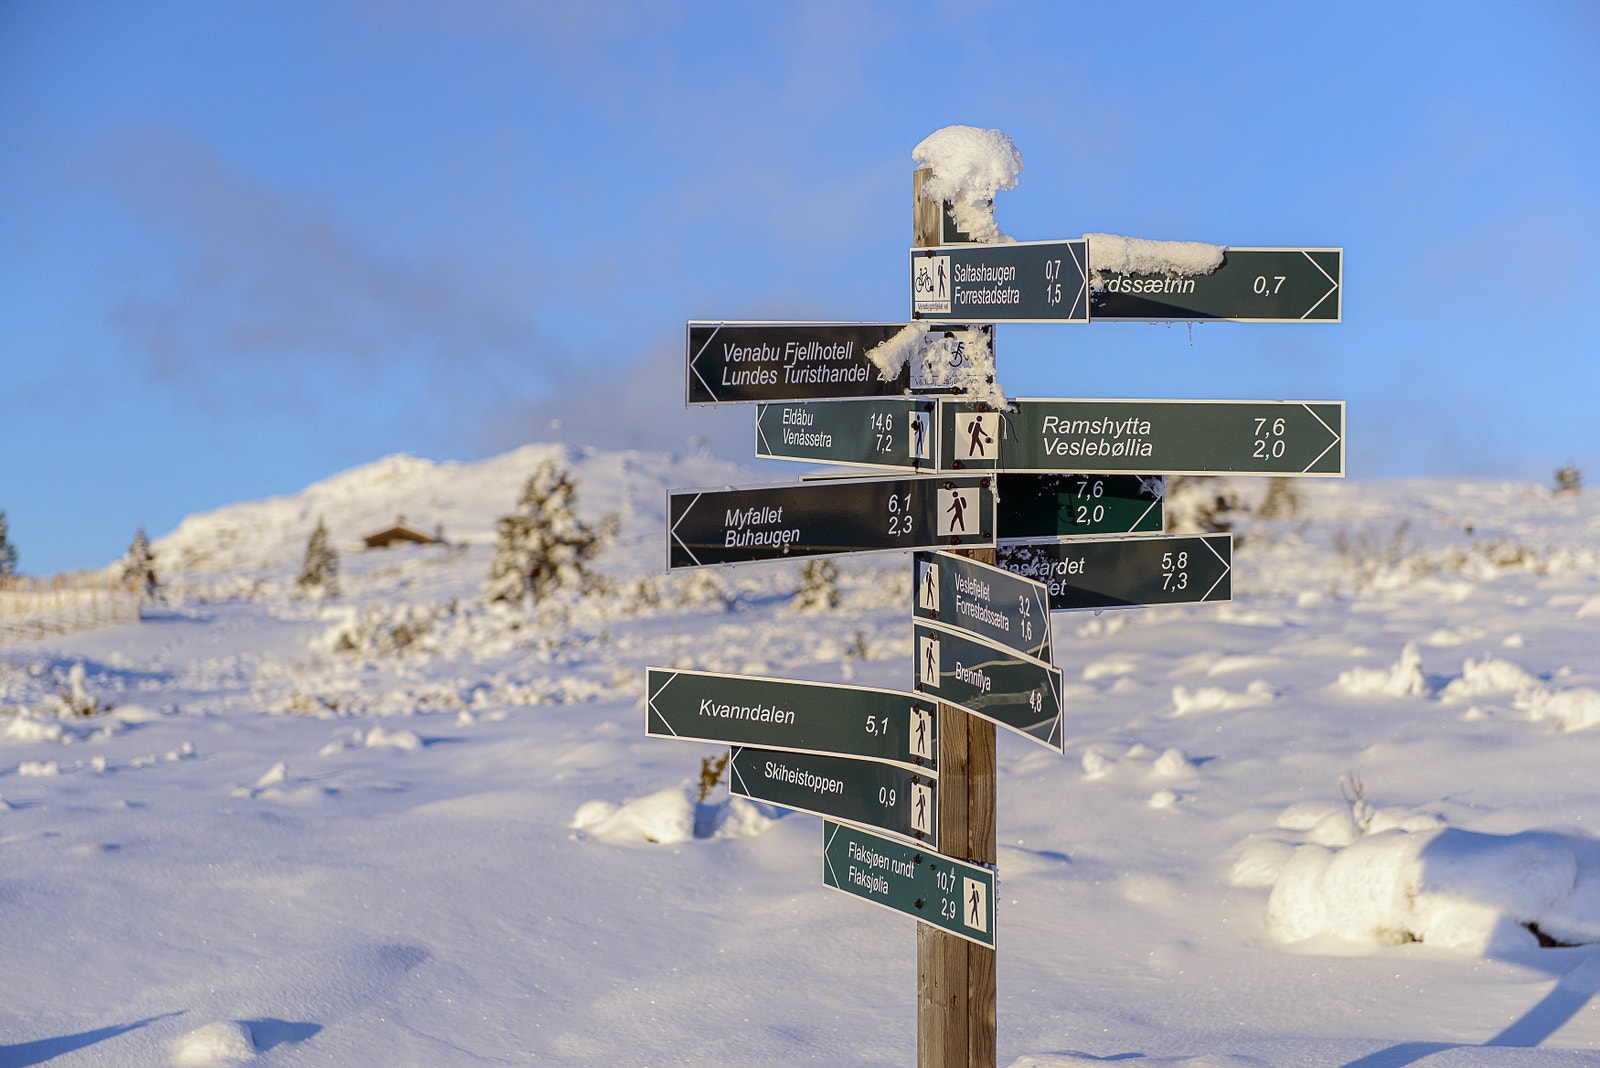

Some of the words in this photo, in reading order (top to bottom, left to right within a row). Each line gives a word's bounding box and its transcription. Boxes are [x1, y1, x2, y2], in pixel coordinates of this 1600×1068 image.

[953, 262, 1016, 286] Saltashaugen
[1045, 259, 1062, 282] 0,7
[953, 285, 1020, 305] Forrestadsetra
[1046, 283, 1062, 308] 1,5
[1253, 276, 1286, 296] 0,7
[722, 342, 780, 363] Venabu
[783, 341, 854, 368] Fjellhotell
[721, 367, 778, 387] Lundes
[783, 363, 870, 384] Turisthandel
[782, 408, 814, 427] Eldåbu
[870, 412, 893, 433] 14,6
[1042, 416, 1151, 438] Ramshytta
[1253, 418, 1286, 439] 7,6
[782, 427, 832, 449] Venåssetra
[876, 433, 893, 454] 7,2
[1042, 438, 1153, 458] Veslebøllia
[1253, 440, 1286, 460] 2,0
[1076, 480, 1104, 501] 7,6
[888, 493, 912, 516] 6,1
[1076, 505, 1104, 526] 2,0
[725, 506, 783, 529] Myfallet
[888, 515, 913, 537] 2,3
[725, 527, 800, 549] Buhaugen
[1162, 551, 1188, 571] 5,8
[954, 573, 991, 602] Veslefjellet
[1162, 573, 1188, 592] 7,3
[956, 595, 1010, 632] Forrestadssætra
[1018, 595, 1031, 618] 3,2
[1020, 619, 1033, 642] 1,6
[955, 661, 992, 694] Brennflya
[699, 699, 796, 725] Kvanndalen
[1029, 689, 1043, 714] 4,8
[865, 715, 889, 736] 5,1
[764, 761, 844, 794] Skiheistoppen
[879, 786, 897, 808] 0,9
[848, 841, 890, 872] Flaksjøen
[891, 857, 915, 879] rundt
[848, 865, 889, 896] Flaksjølia
[936, 869, 956, 894] 10,7
[941, 900, 957, 920] 2,9
